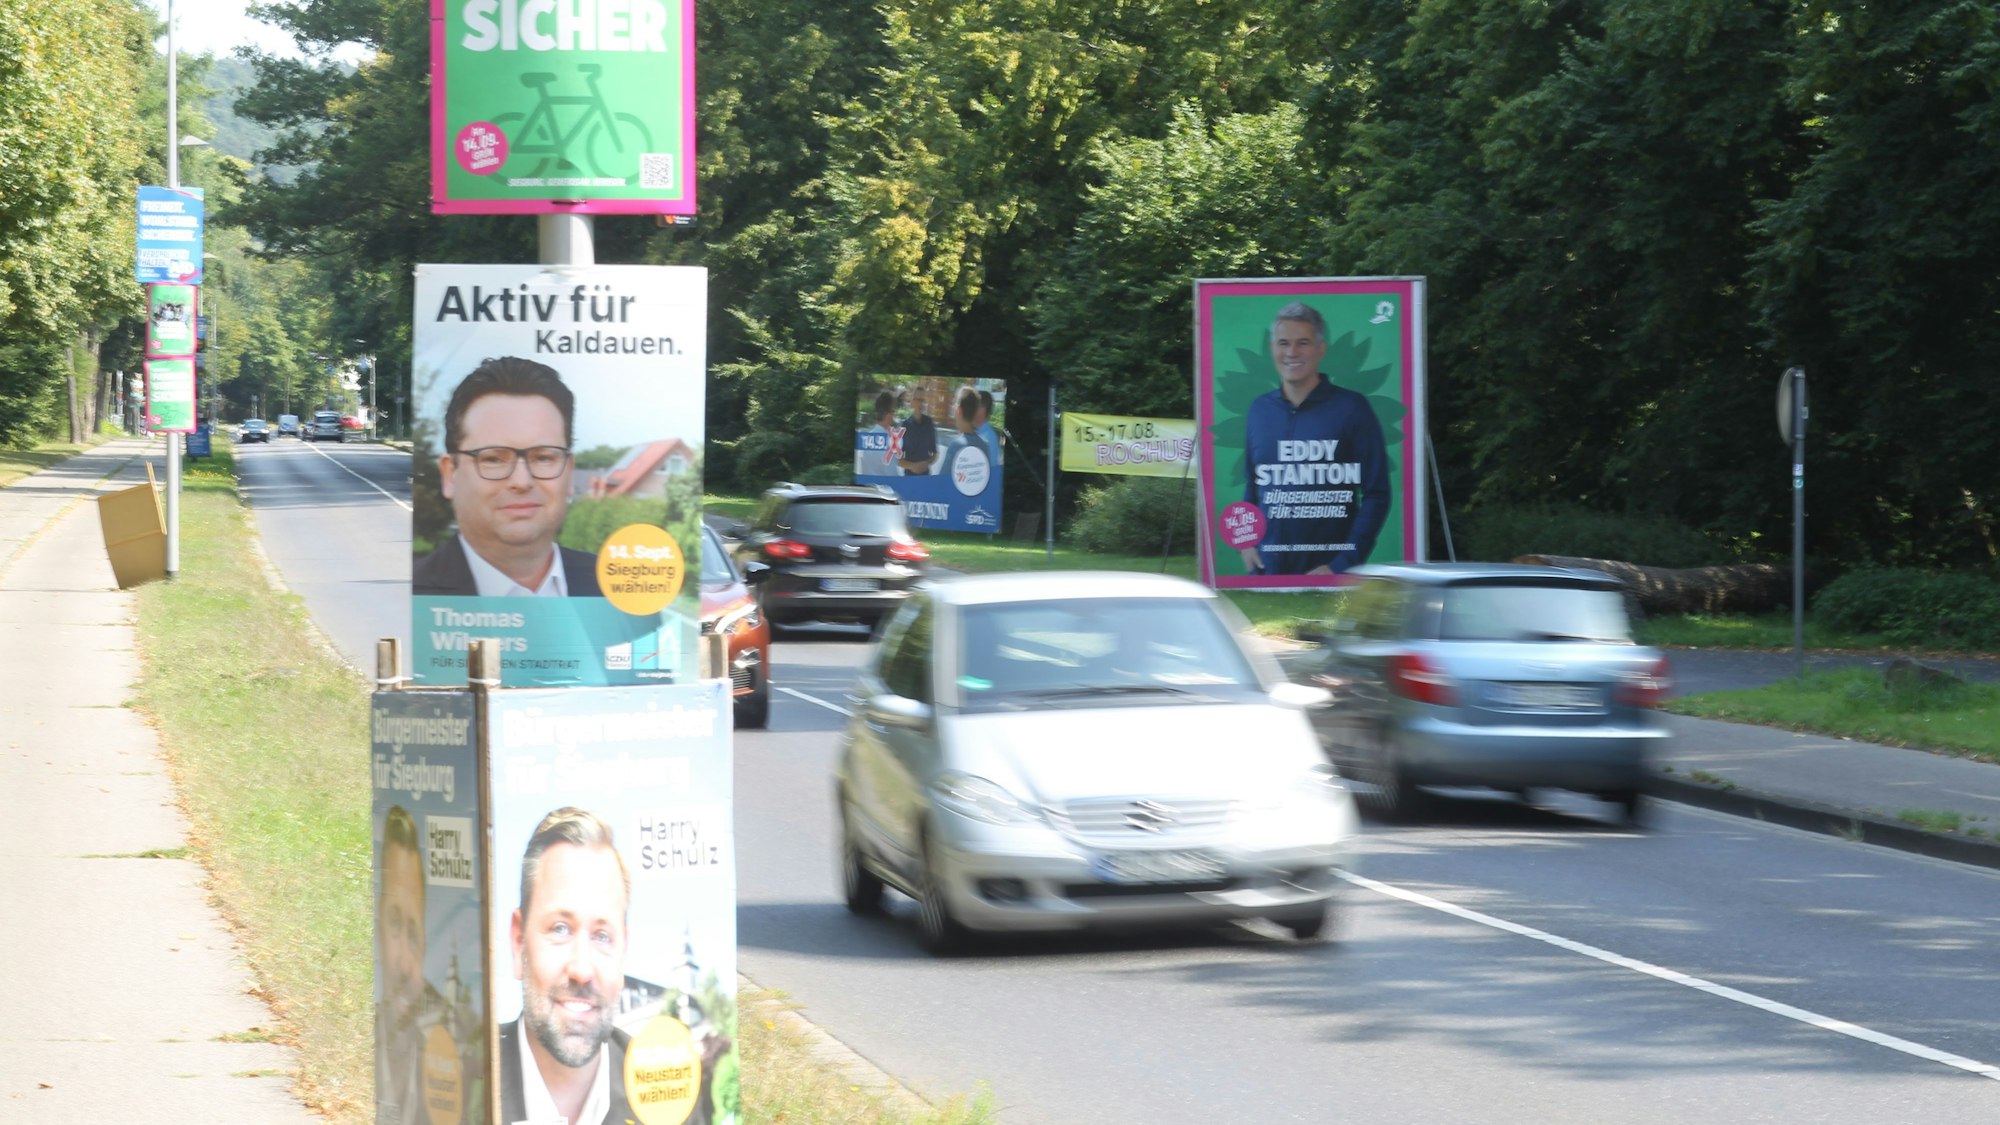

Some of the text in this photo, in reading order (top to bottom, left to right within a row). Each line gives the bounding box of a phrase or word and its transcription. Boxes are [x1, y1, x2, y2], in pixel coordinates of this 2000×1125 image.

[462, 0, 668, 51] SICHER
[436, 283, 636, 322] Aktiv für
[535, 329, 683, 355] Kaldauen.
[1095, 438, 1193, 466] ROCHUS
[1277, 439, 1339, 462] EDDY
[1254, 463, 1361, 486] STANTON
[1264, 489, 1354, 504] BÜRGERMEISTER
[1268, 504, 1348, 519] FÜR SIEGBURG.
[606, 563, 676, 579] Siegburg
[431, 607, 526, 628] Thomas
[430, 631, 529, 652] Wilers
[373, 707, 470, 754] Bürgermeister
[503, 702, 717, 754] Bürgermeister
[373, 753, 456, 803] für Siegburg
[504, 755, 552, 795] für
[428, 822, 461, 857] Harry
[640, 817, 700, 846] Harry
[429, 851, 473, 880] Schulz
[641, 841, 719, 871] Schulz
